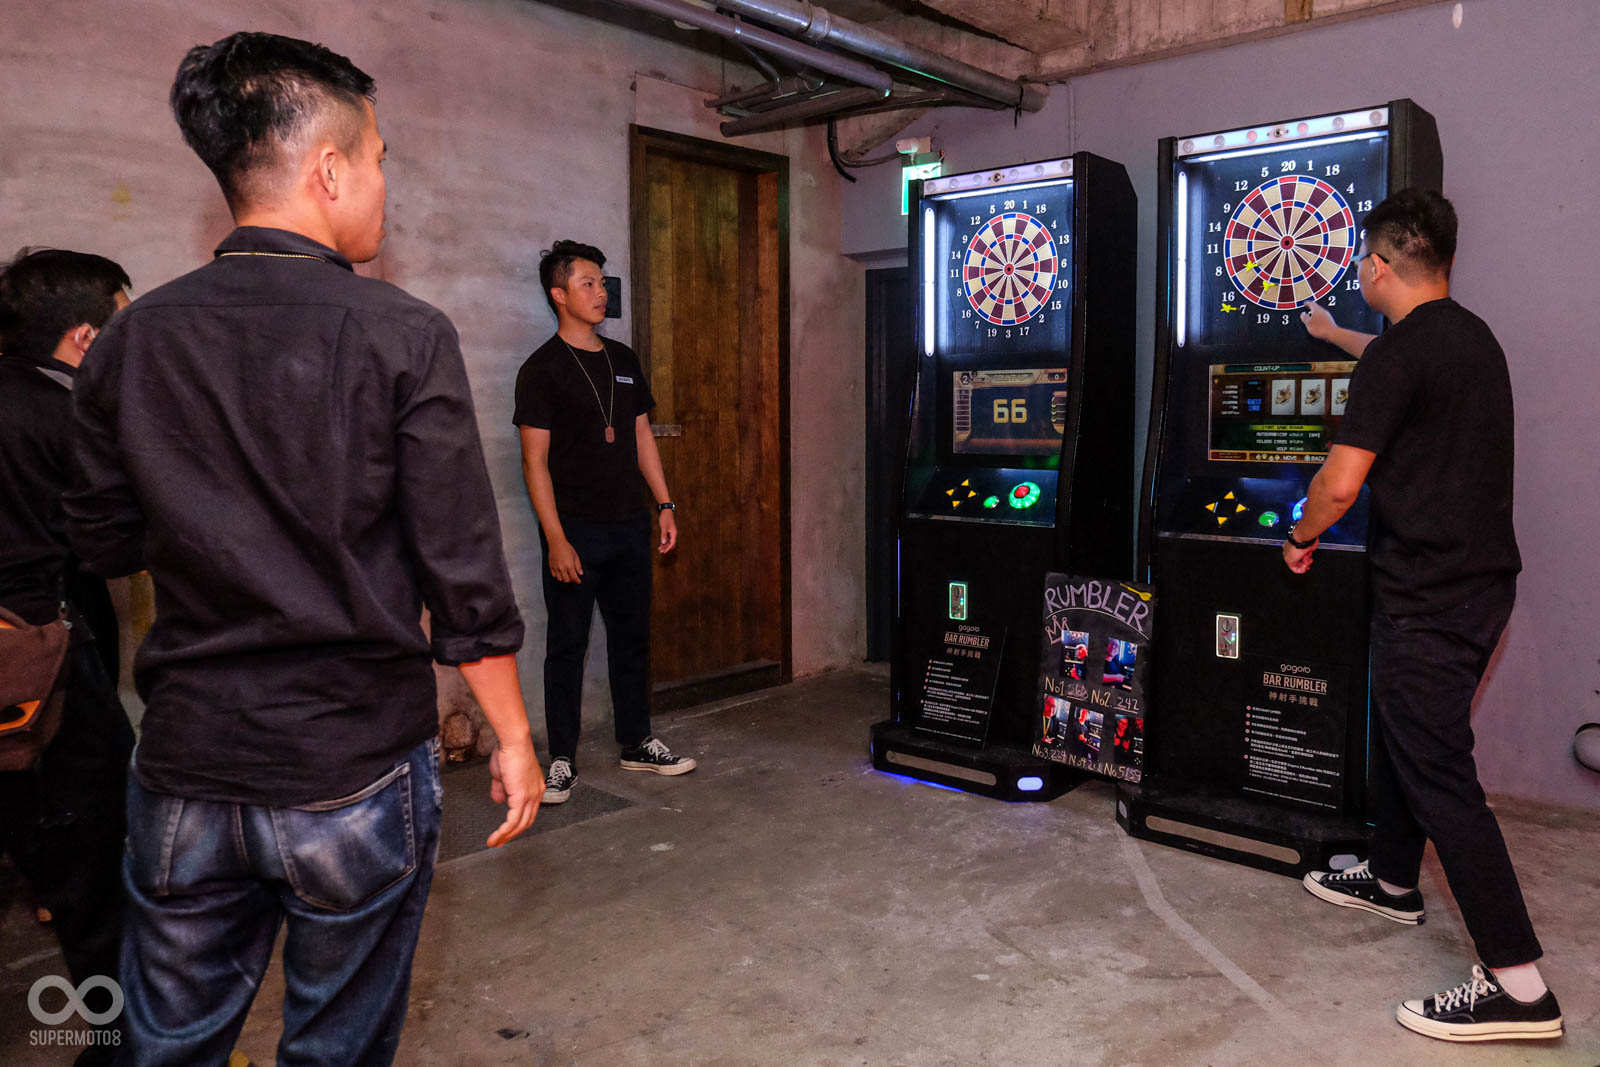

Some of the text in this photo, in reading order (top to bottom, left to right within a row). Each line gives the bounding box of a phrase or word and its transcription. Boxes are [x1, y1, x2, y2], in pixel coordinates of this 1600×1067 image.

[1281, 160, 1296, 172] 20
[1307, 160, 1314, 170] 1
[1262, 167, 1269, 178] 5
[1325, 165, 1340, 176] 18
[1234, 180, 1248, 192] 12
[1346, 183, 1355, 194] 4
[990, 205, 996, 214] 5
[1004, 200, 1015, 210] 20
[1022, 200, 1028, 210] 1
[1036, 204, 1046, 214] 18
[1224, 203, 1230, 214] 9
[1357, 200, 1372, 212] 13
[970, 216, 980, 226] 12
[1050, 220, 1056, 229] 4
[1208, 222, 1222, 232] 14
[962, 235, 968, 244] 9
[1058, 235, 1070, 244] 13
[1207, 244, 1219, 254] 11
[951, 251, 961, 260] 14
[1061, 258, 1067, 268] 6
[1216, 266, 1222, 276] 8
[1058, 280, 1068, 288] 10
[1346, 280, 1360, 290] 15
[956, 288, 962, 296] 8
[1222, 292, 1234, 302] 16
[1051, 301, 1062, 310] 15
[1328, 296, 1336, 306] 2
[962, 310, 971, 318] 16
[1240, 304, 1247, 314] 7
[1038, 314, 1044, 322] 2
[1256, 314, 1270, 324] 19
[1282, 315, 1289, 324] 3
[974, 320, 980, 329] 7
[987, 328, 997, 337] 19
[1006, 330, 1011, 338] 3
[1020, 327, 1030, 336] 17
[994, 399, 1028, 424] 66
[1044, 580, 1149, 632] RUMBLER
[944, 632, 990, 648] BAR RUMBLER
[1280, 664, 1310, 674] gogoro
[1263, 674, 1328, 693] BAR RUMBLER
